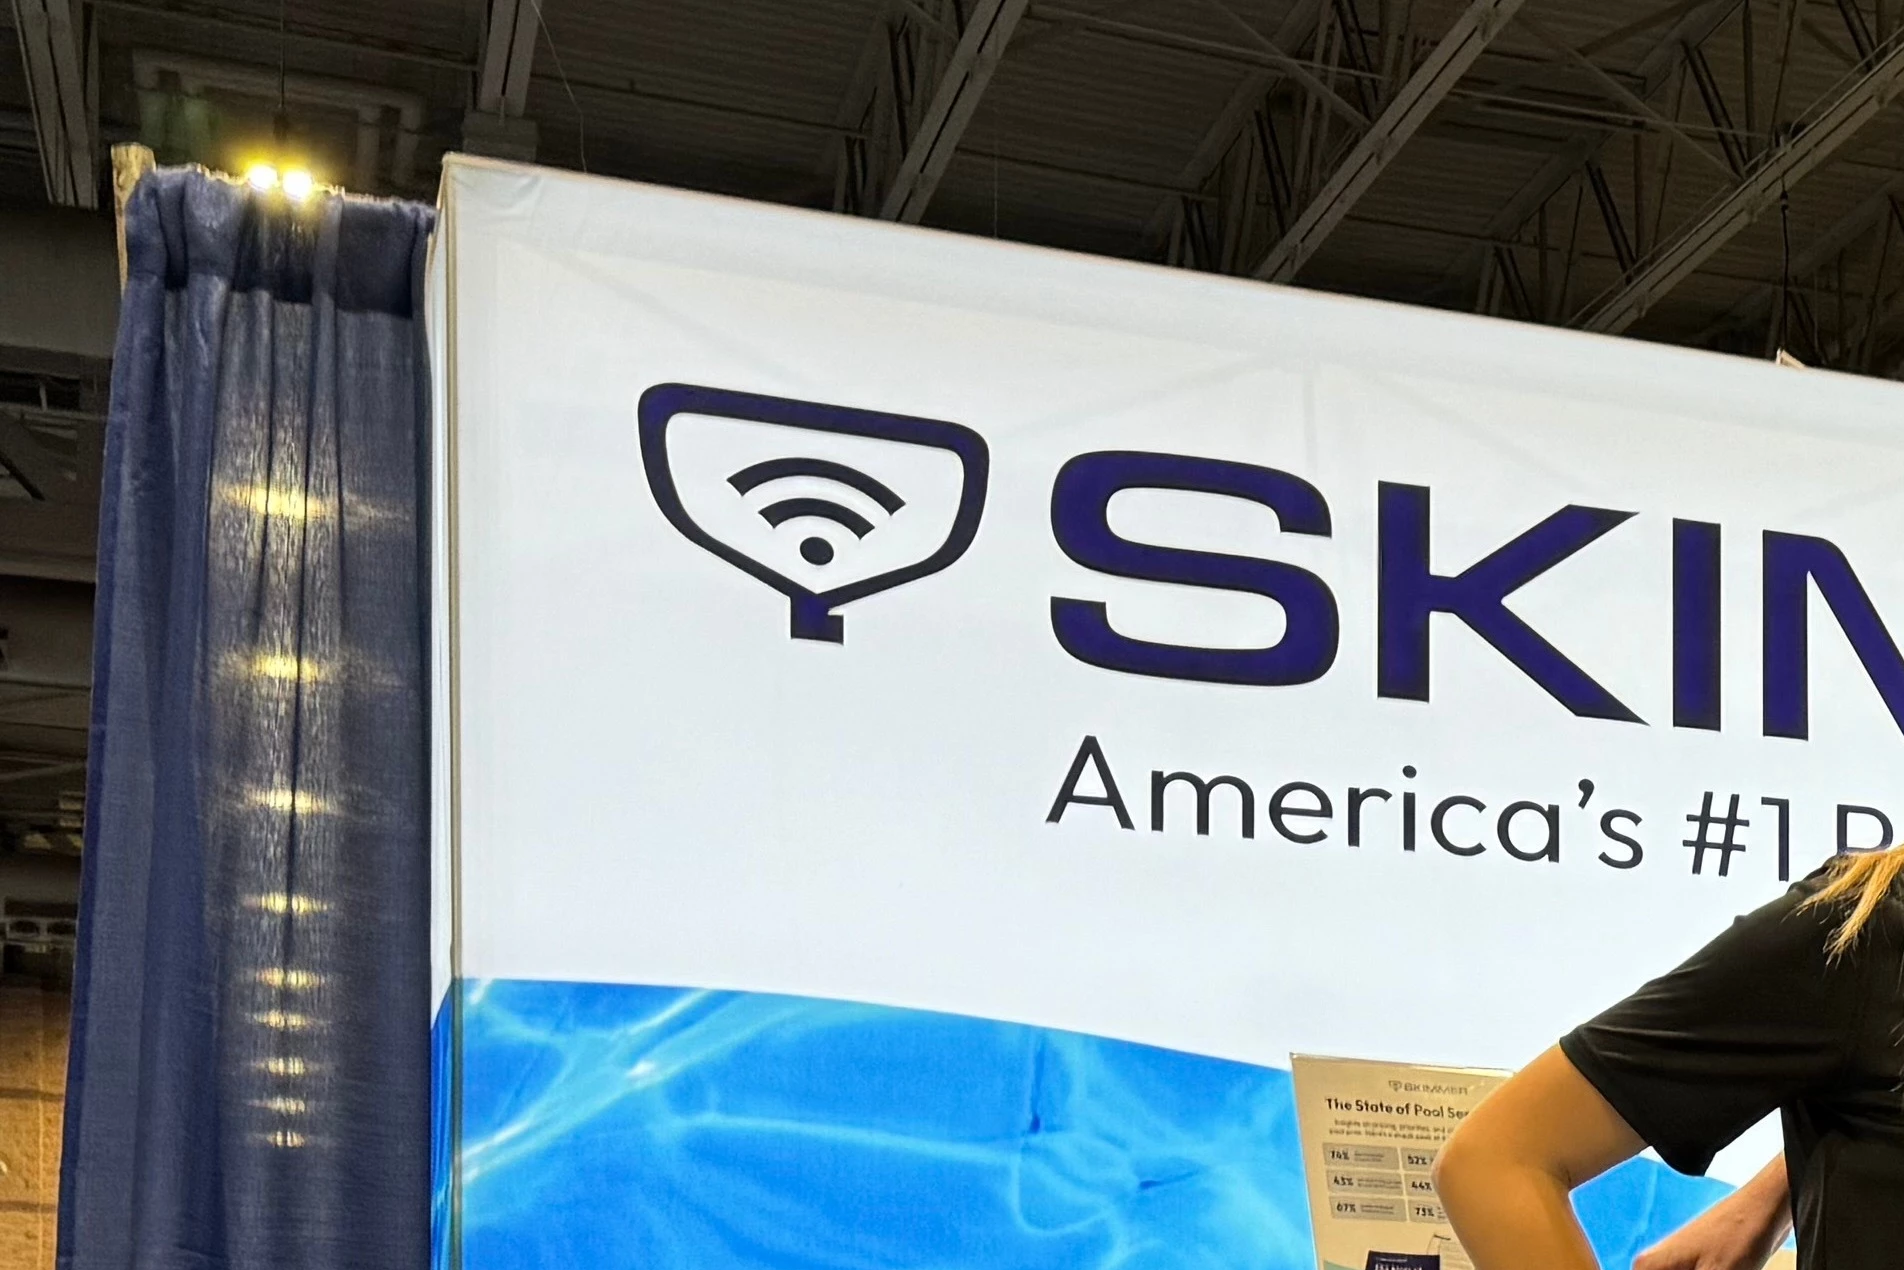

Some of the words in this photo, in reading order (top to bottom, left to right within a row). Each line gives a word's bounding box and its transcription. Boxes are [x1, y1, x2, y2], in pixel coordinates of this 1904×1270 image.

[1046, 735, 1645, 869] America's
[1682, 790, 1790, 882] #1
[1326, 1097, 1352, 1111] The
[1355, 1099, 1393, 1114] State
[1395, 1101, 1410, 1116] of
[1414, 1103, 1444, 1118] Pool
